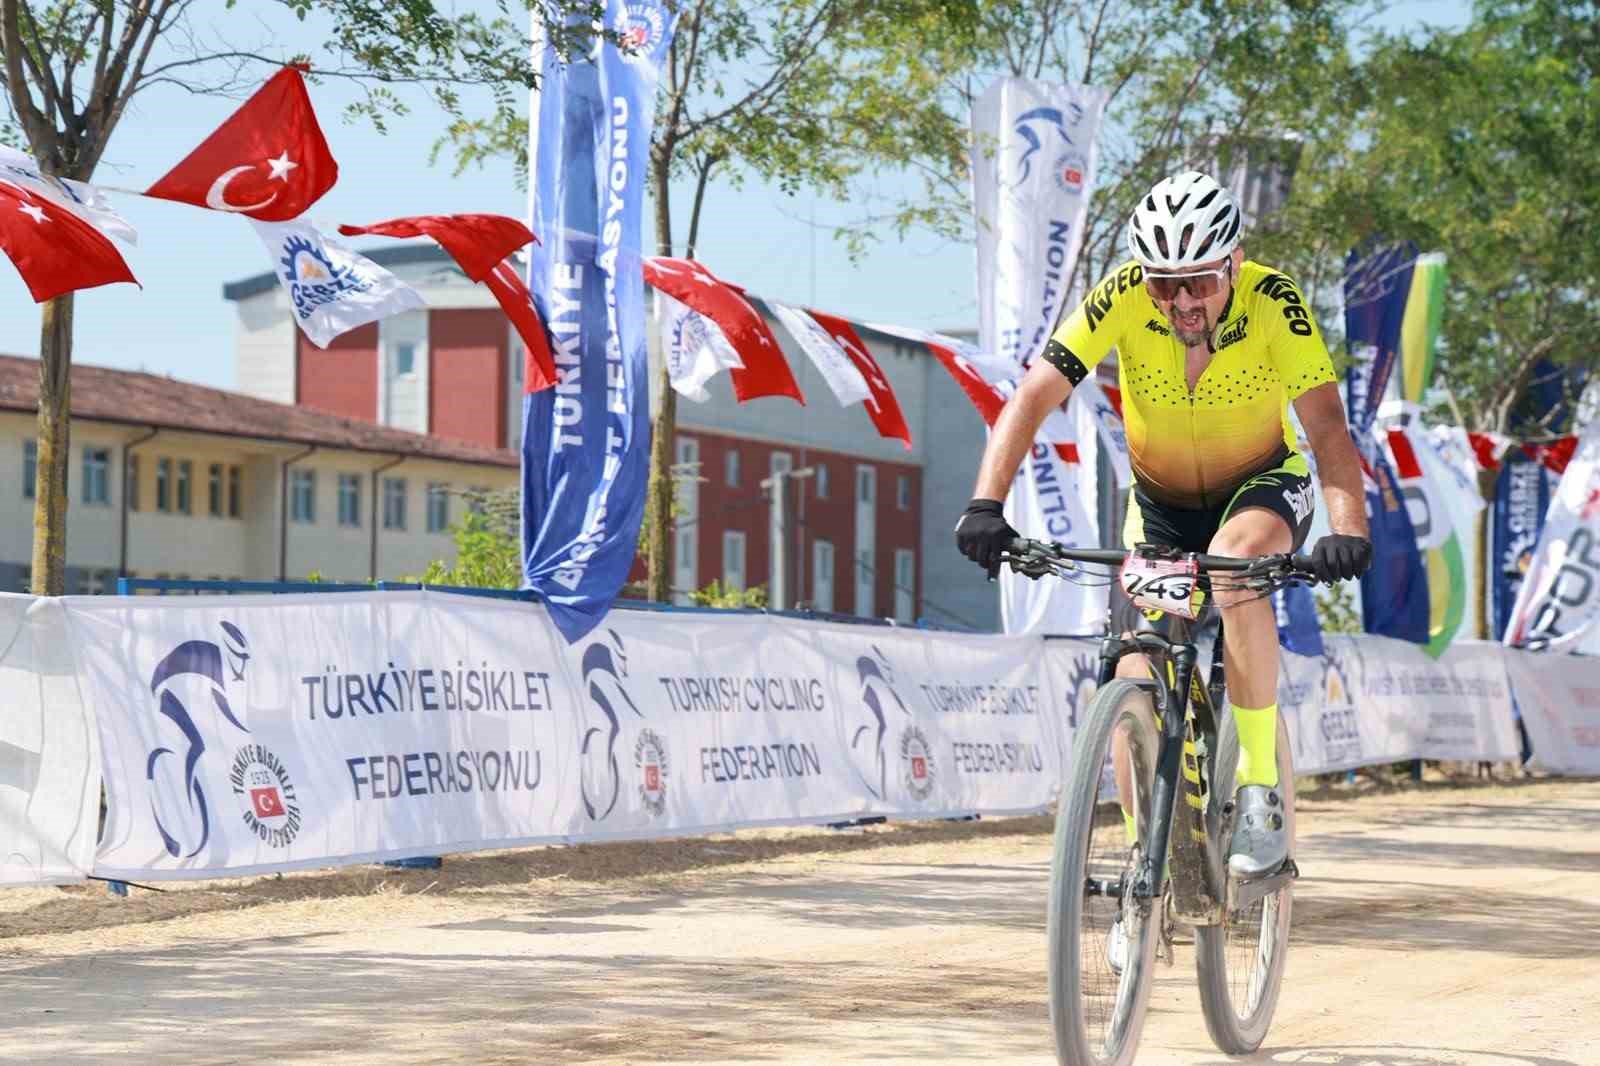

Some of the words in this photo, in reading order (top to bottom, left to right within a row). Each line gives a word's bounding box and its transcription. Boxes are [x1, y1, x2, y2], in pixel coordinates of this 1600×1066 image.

[1125, 573, 1191, 601] 243
[302, 662, 439, 720] TÜRKİYE
[441, 660, 553, 711] BİSİKLET
[659, 677, 740, 712] TURKISH
[744, 678, 825, 712] CYCLING
[346, 750, 541, 800] FEDERASYONU
[701, 743, 822, 783] FEDERATION
